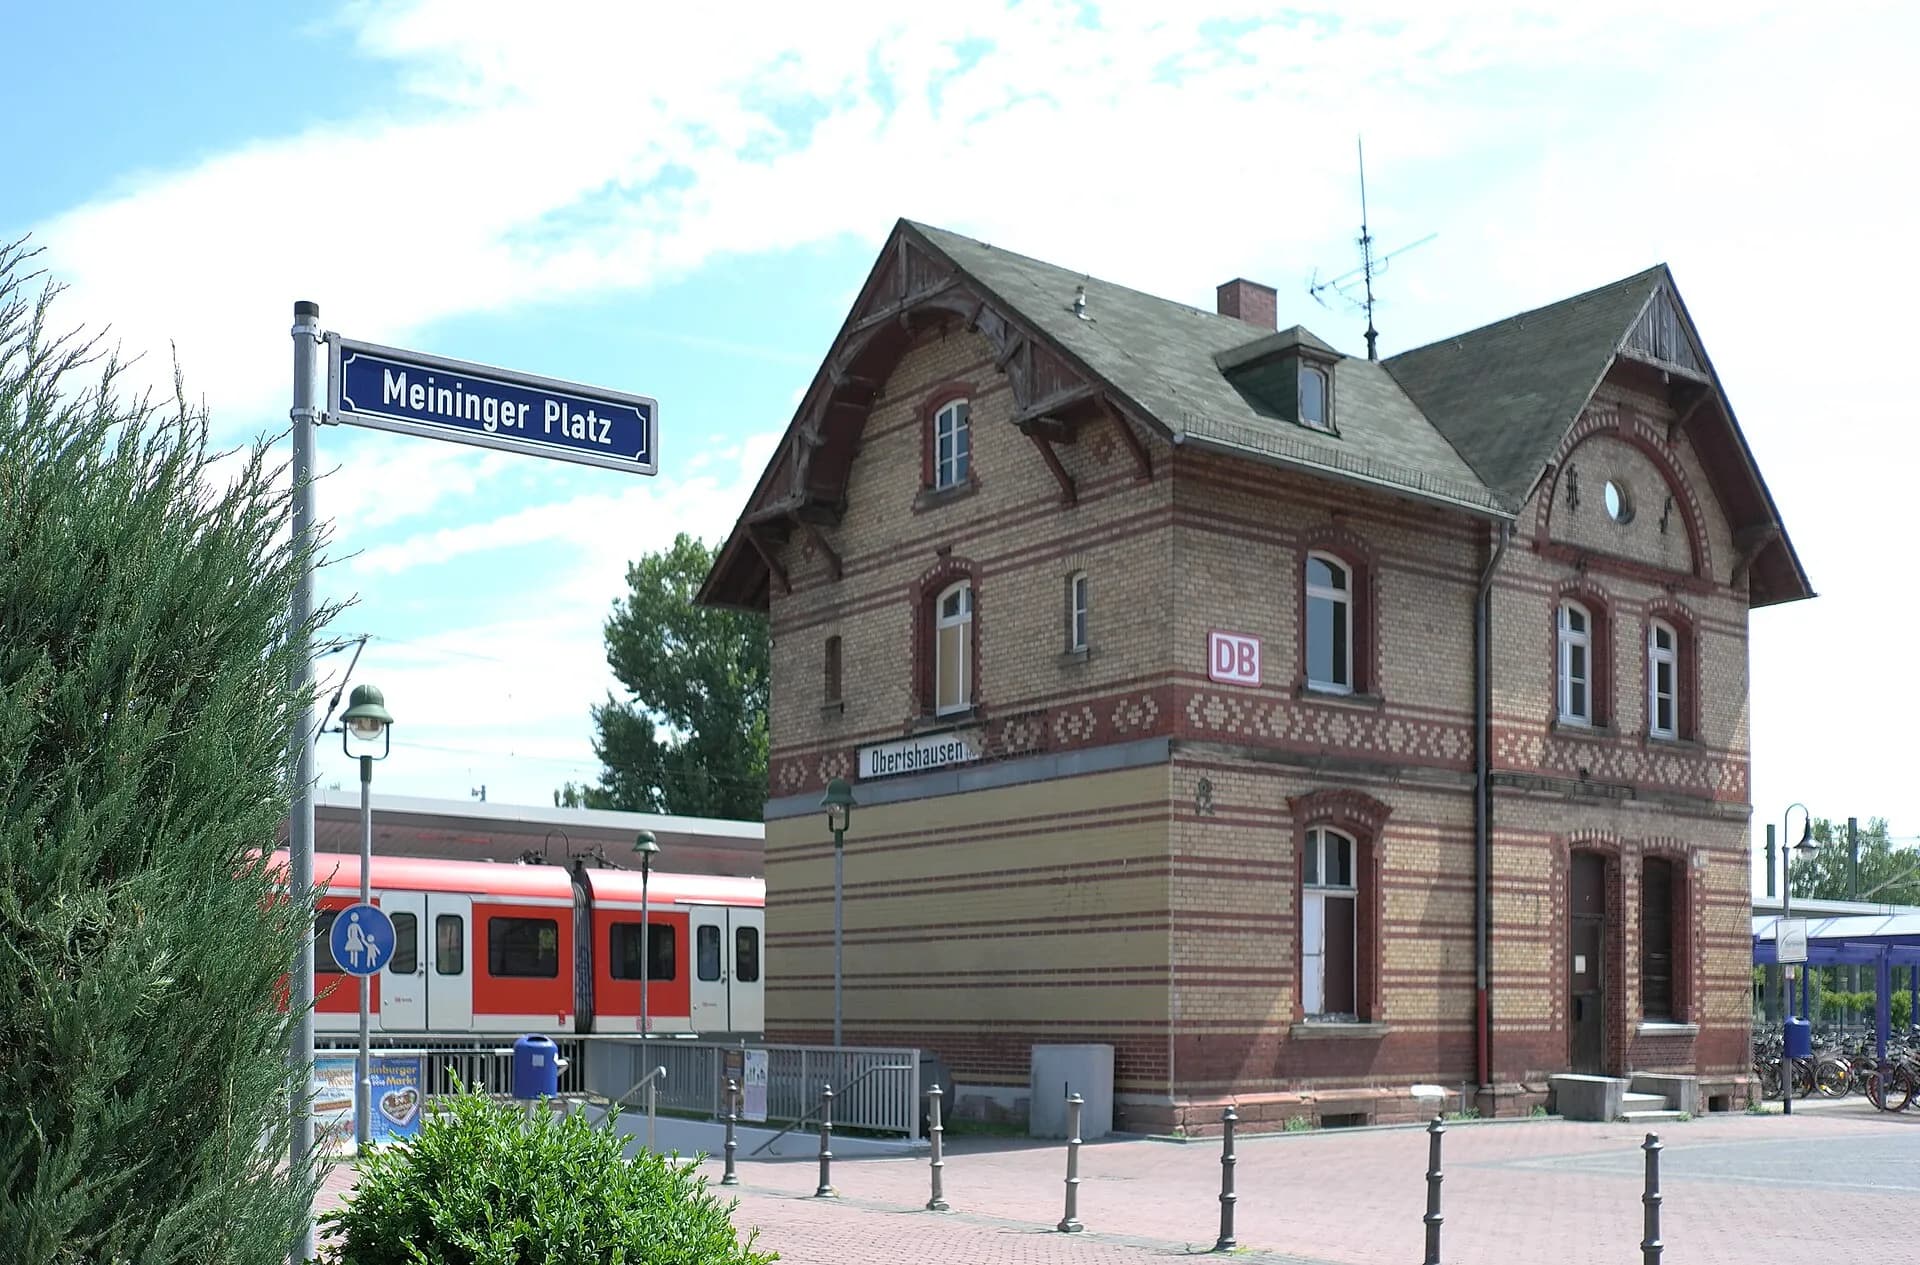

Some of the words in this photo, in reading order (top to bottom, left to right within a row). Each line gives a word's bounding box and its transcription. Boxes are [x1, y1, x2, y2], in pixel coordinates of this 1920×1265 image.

[383, 368, 530, 432] Meininger
[544, 399, 612, 445] Platz
[1216, 638, 1256, 676] DB
[871, 742, 963, 774] Obertshausen
